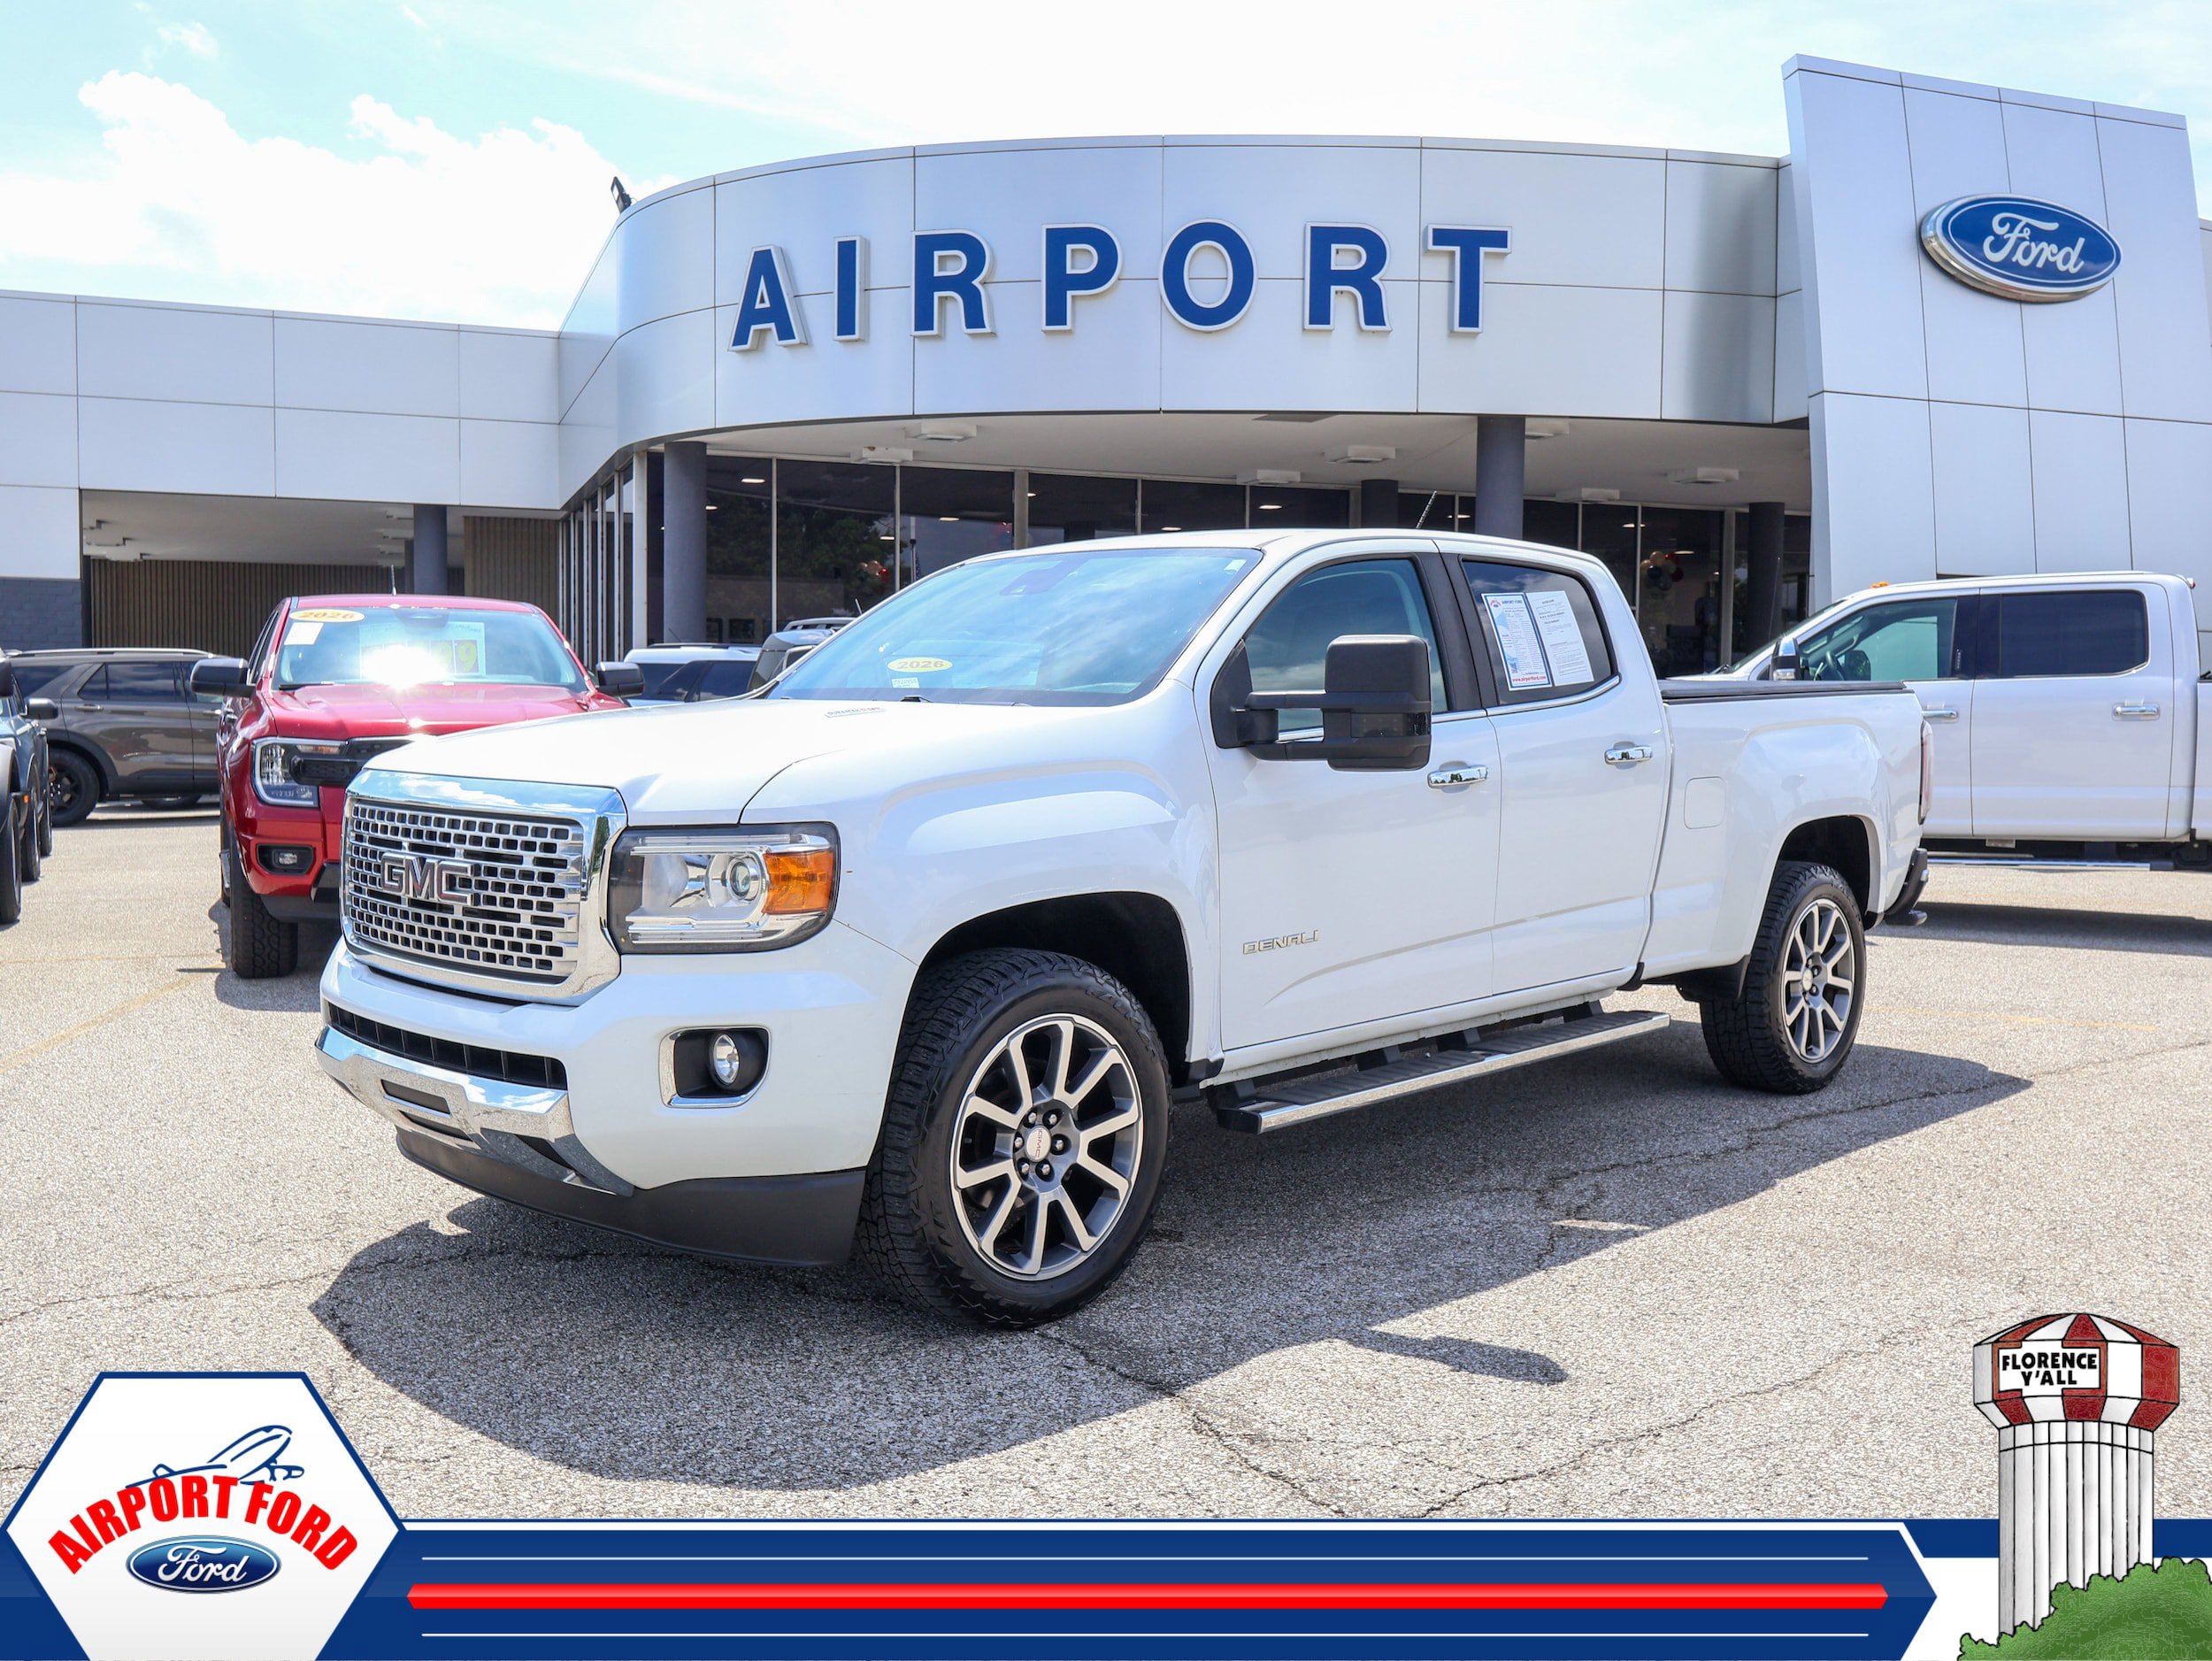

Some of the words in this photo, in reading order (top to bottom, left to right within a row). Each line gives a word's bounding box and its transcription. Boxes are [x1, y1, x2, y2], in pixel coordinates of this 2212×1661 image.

[1983, 212, 2085, 273] Ford
[727, 218, 1512, 352] AIRPORT
[897, 660, 944, 669] 2026
[380, 852, 477, 907] GMC
[1243, 929, 1318, 955] DENALI
